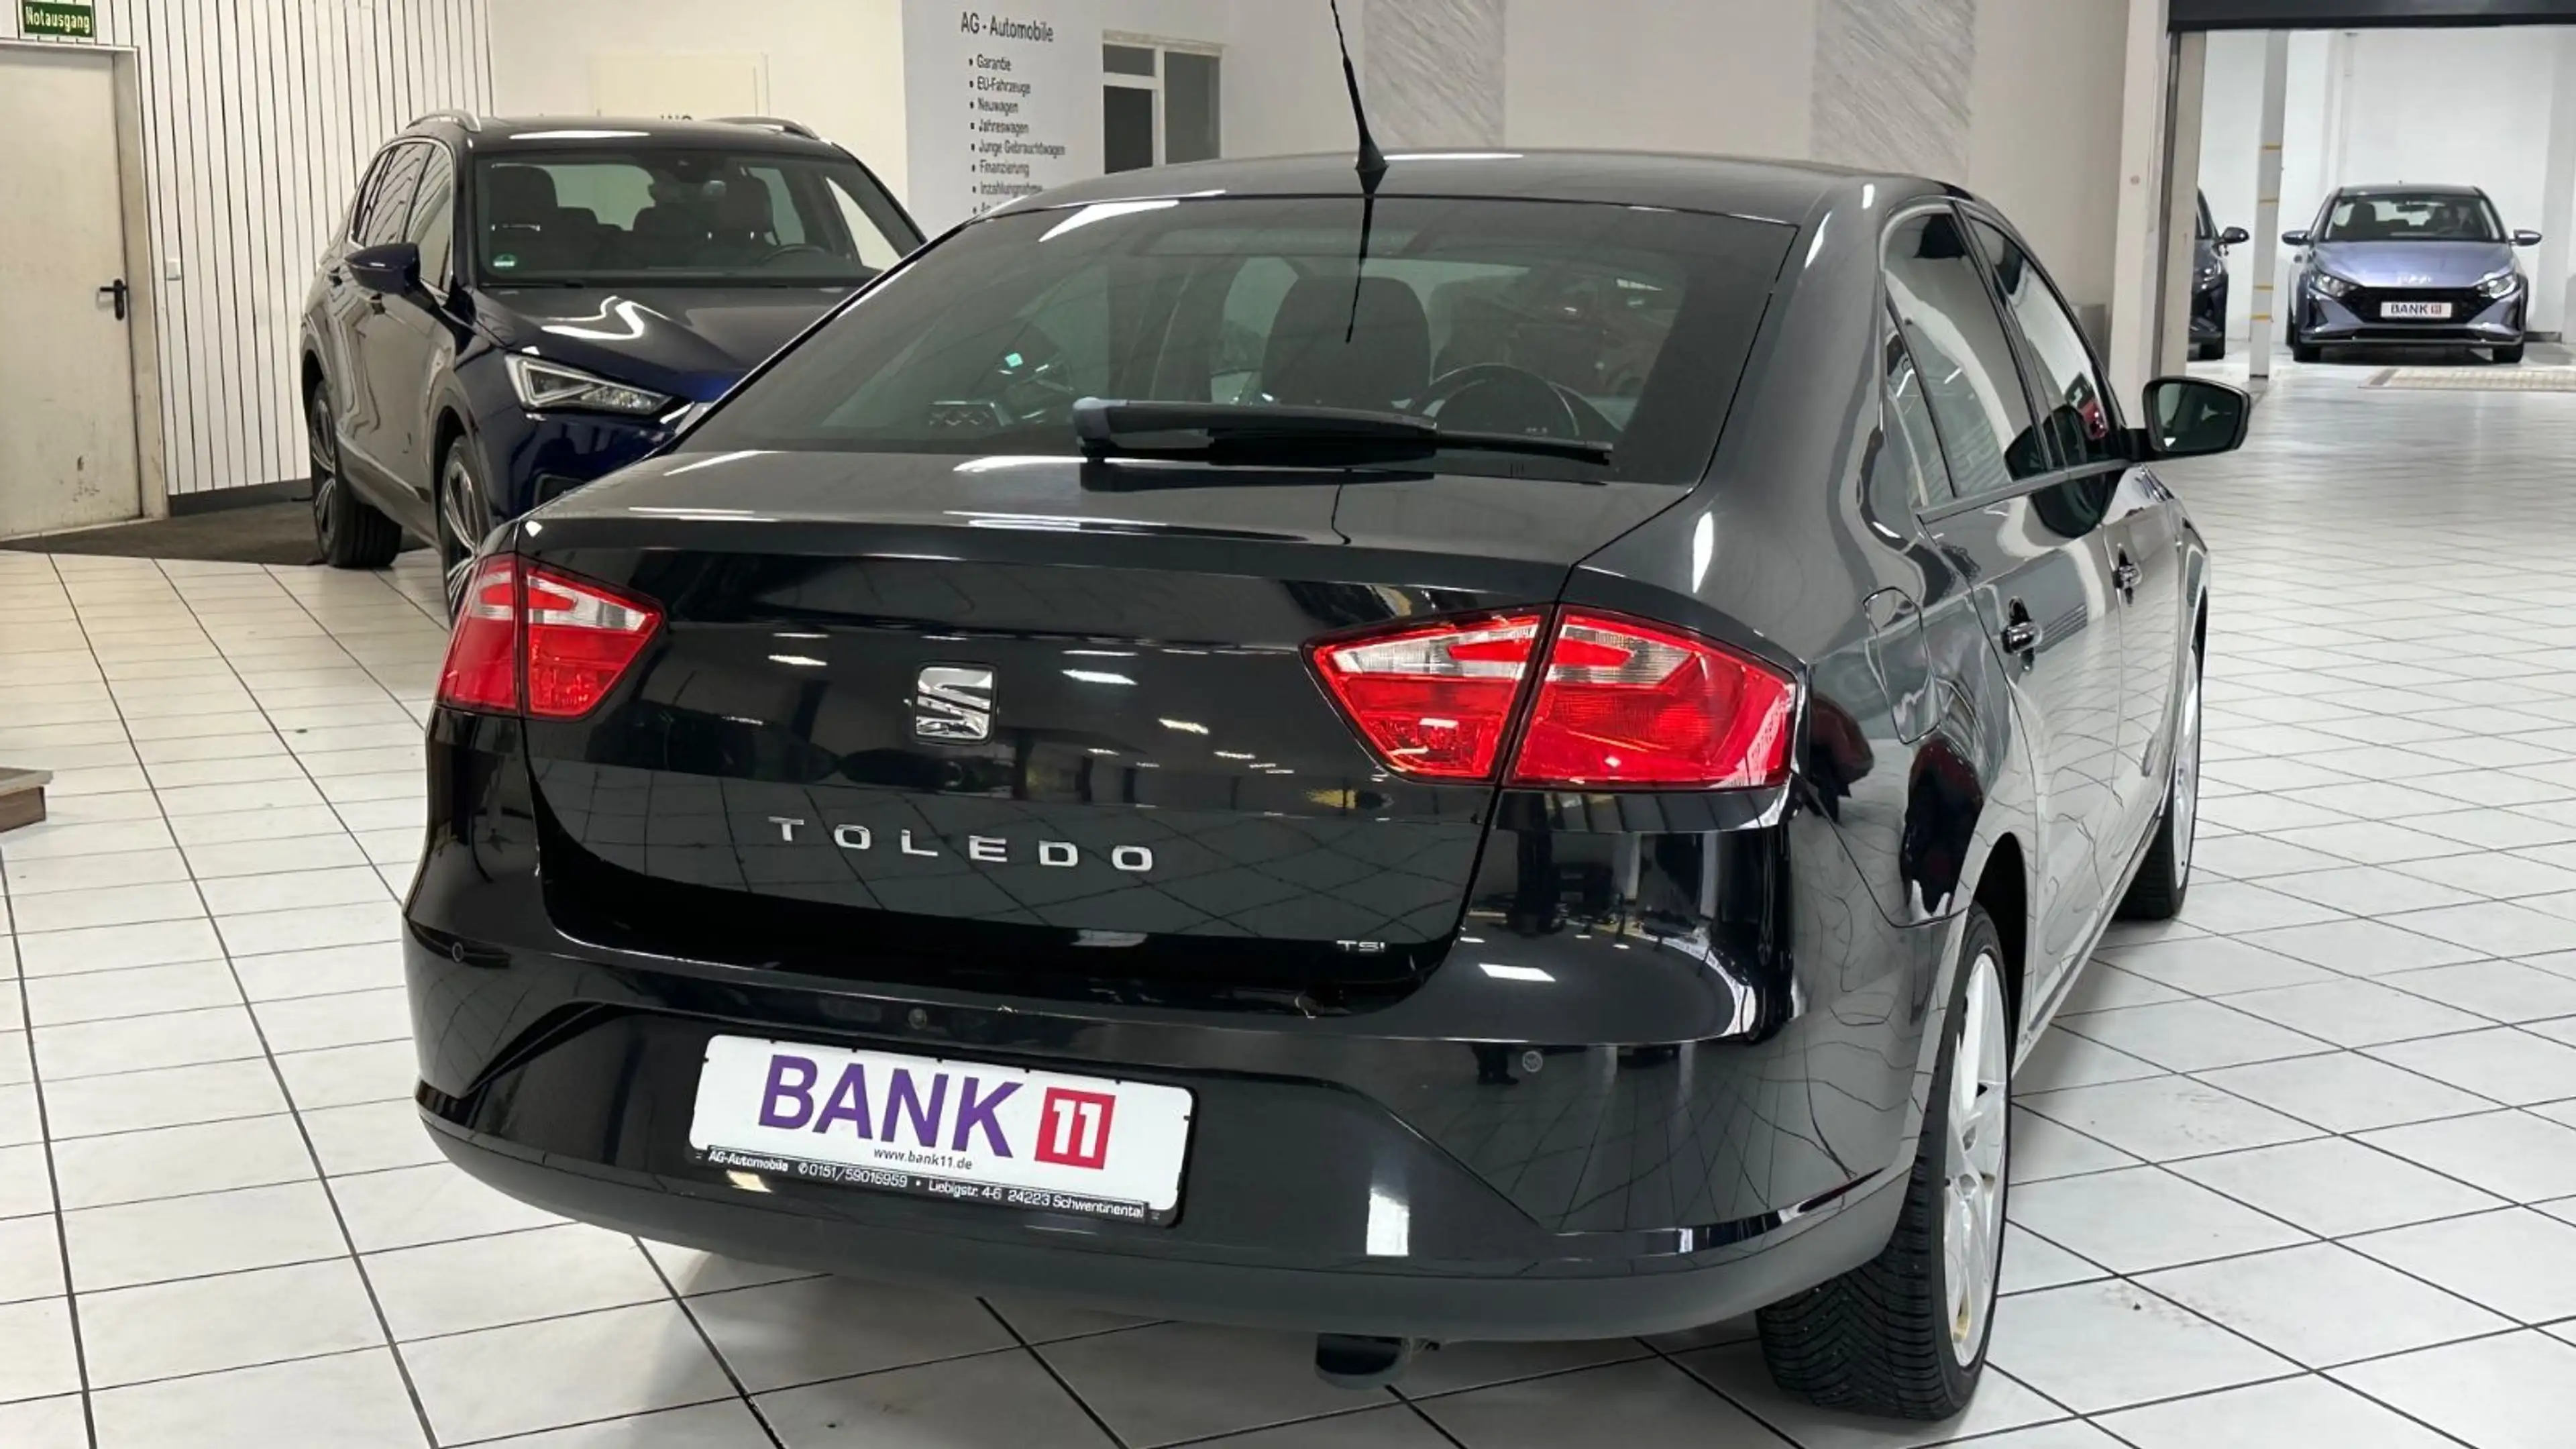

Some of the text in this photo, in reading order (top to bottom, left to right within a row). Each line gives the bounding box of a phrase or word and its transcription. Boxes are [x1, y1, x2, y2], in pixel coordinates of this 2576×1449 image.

[25, 6, 90, 34] Notausgang
[961, 11, 980, 34] AG
[989, 15, 1054, 42] Automobile
[977, 54, 1011, 71] Garantie
[977, 76, 1031, 97] EU-Fahrzeuge
[977, 97, 1018, 116] Neuwagen
[979, 119, 1029, 137] Jahreswagen
[979, 138, 1065, 159] Junge Gebrauchtwagen
[979, 159, 1029, 178] Finanzierung
[2390, 304, 2428, 315] BANK
[768, 816, 1153, 871] TOLEDO
[1336, 940, 1385, 953] TSI
[758, 1054, 1106, 1161] BANK 11
[874, 1148, 973, 1170] www.bank11.de
[708, 1148, 788, 1172] AG-Automobile
[928, 1179, 978, 1197] Liebigstr.
[981, 1185, 1002, 1201] 4-6
[1008, 1189, 1050, 1206] 24223
[1053, 1194, 1144, 1219] Schwentinental
